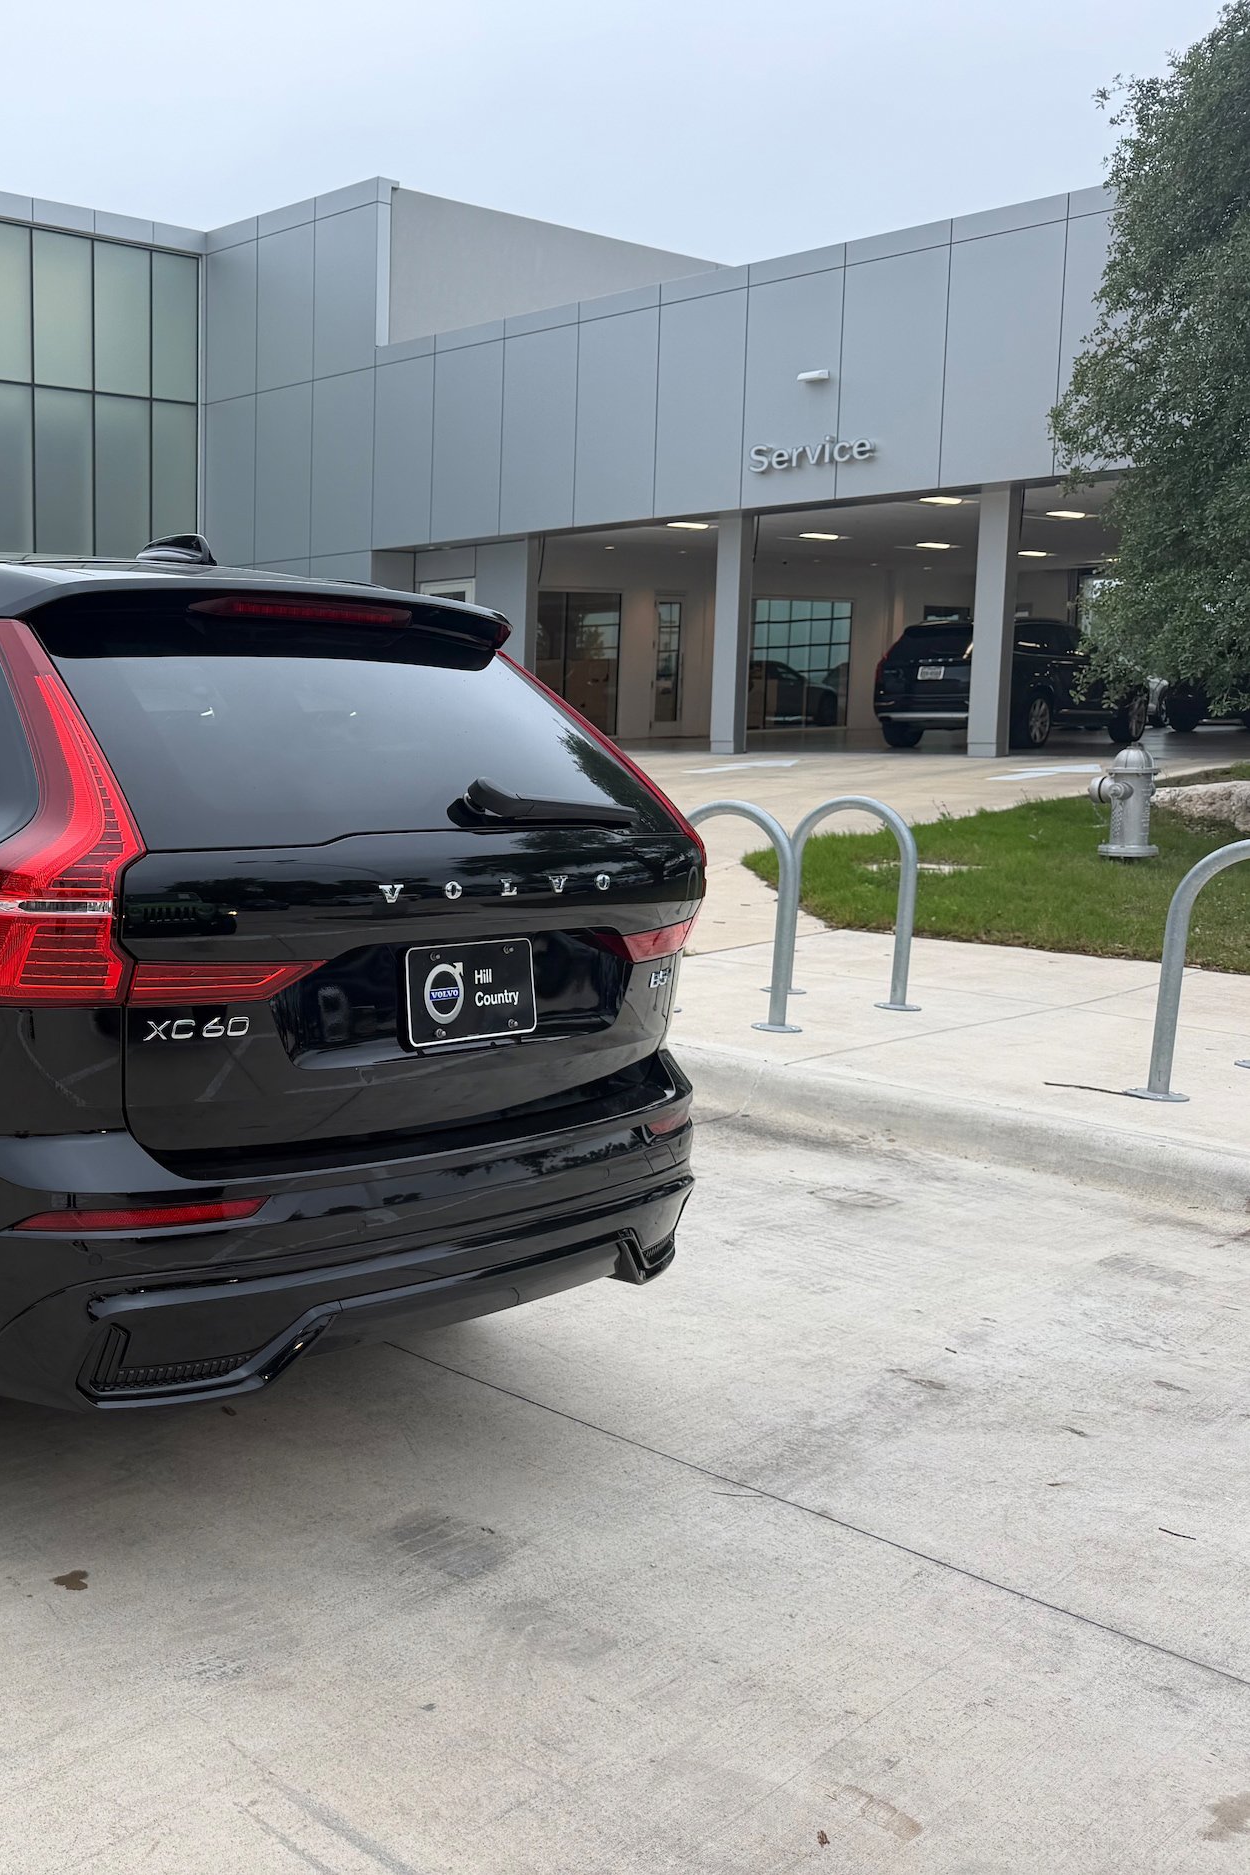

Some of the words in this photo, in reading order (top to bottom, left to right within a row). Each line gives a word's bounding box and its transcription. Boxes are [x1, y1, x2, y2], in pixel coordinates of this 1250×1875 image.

[749, 434, 874, 473] Service
[378, 873, 612, 904] VOLVO
[474, 968, 492, 985] Hill
[430, 988, 459, 999] VOLVO
[474, 989, 519, 1007] Country
